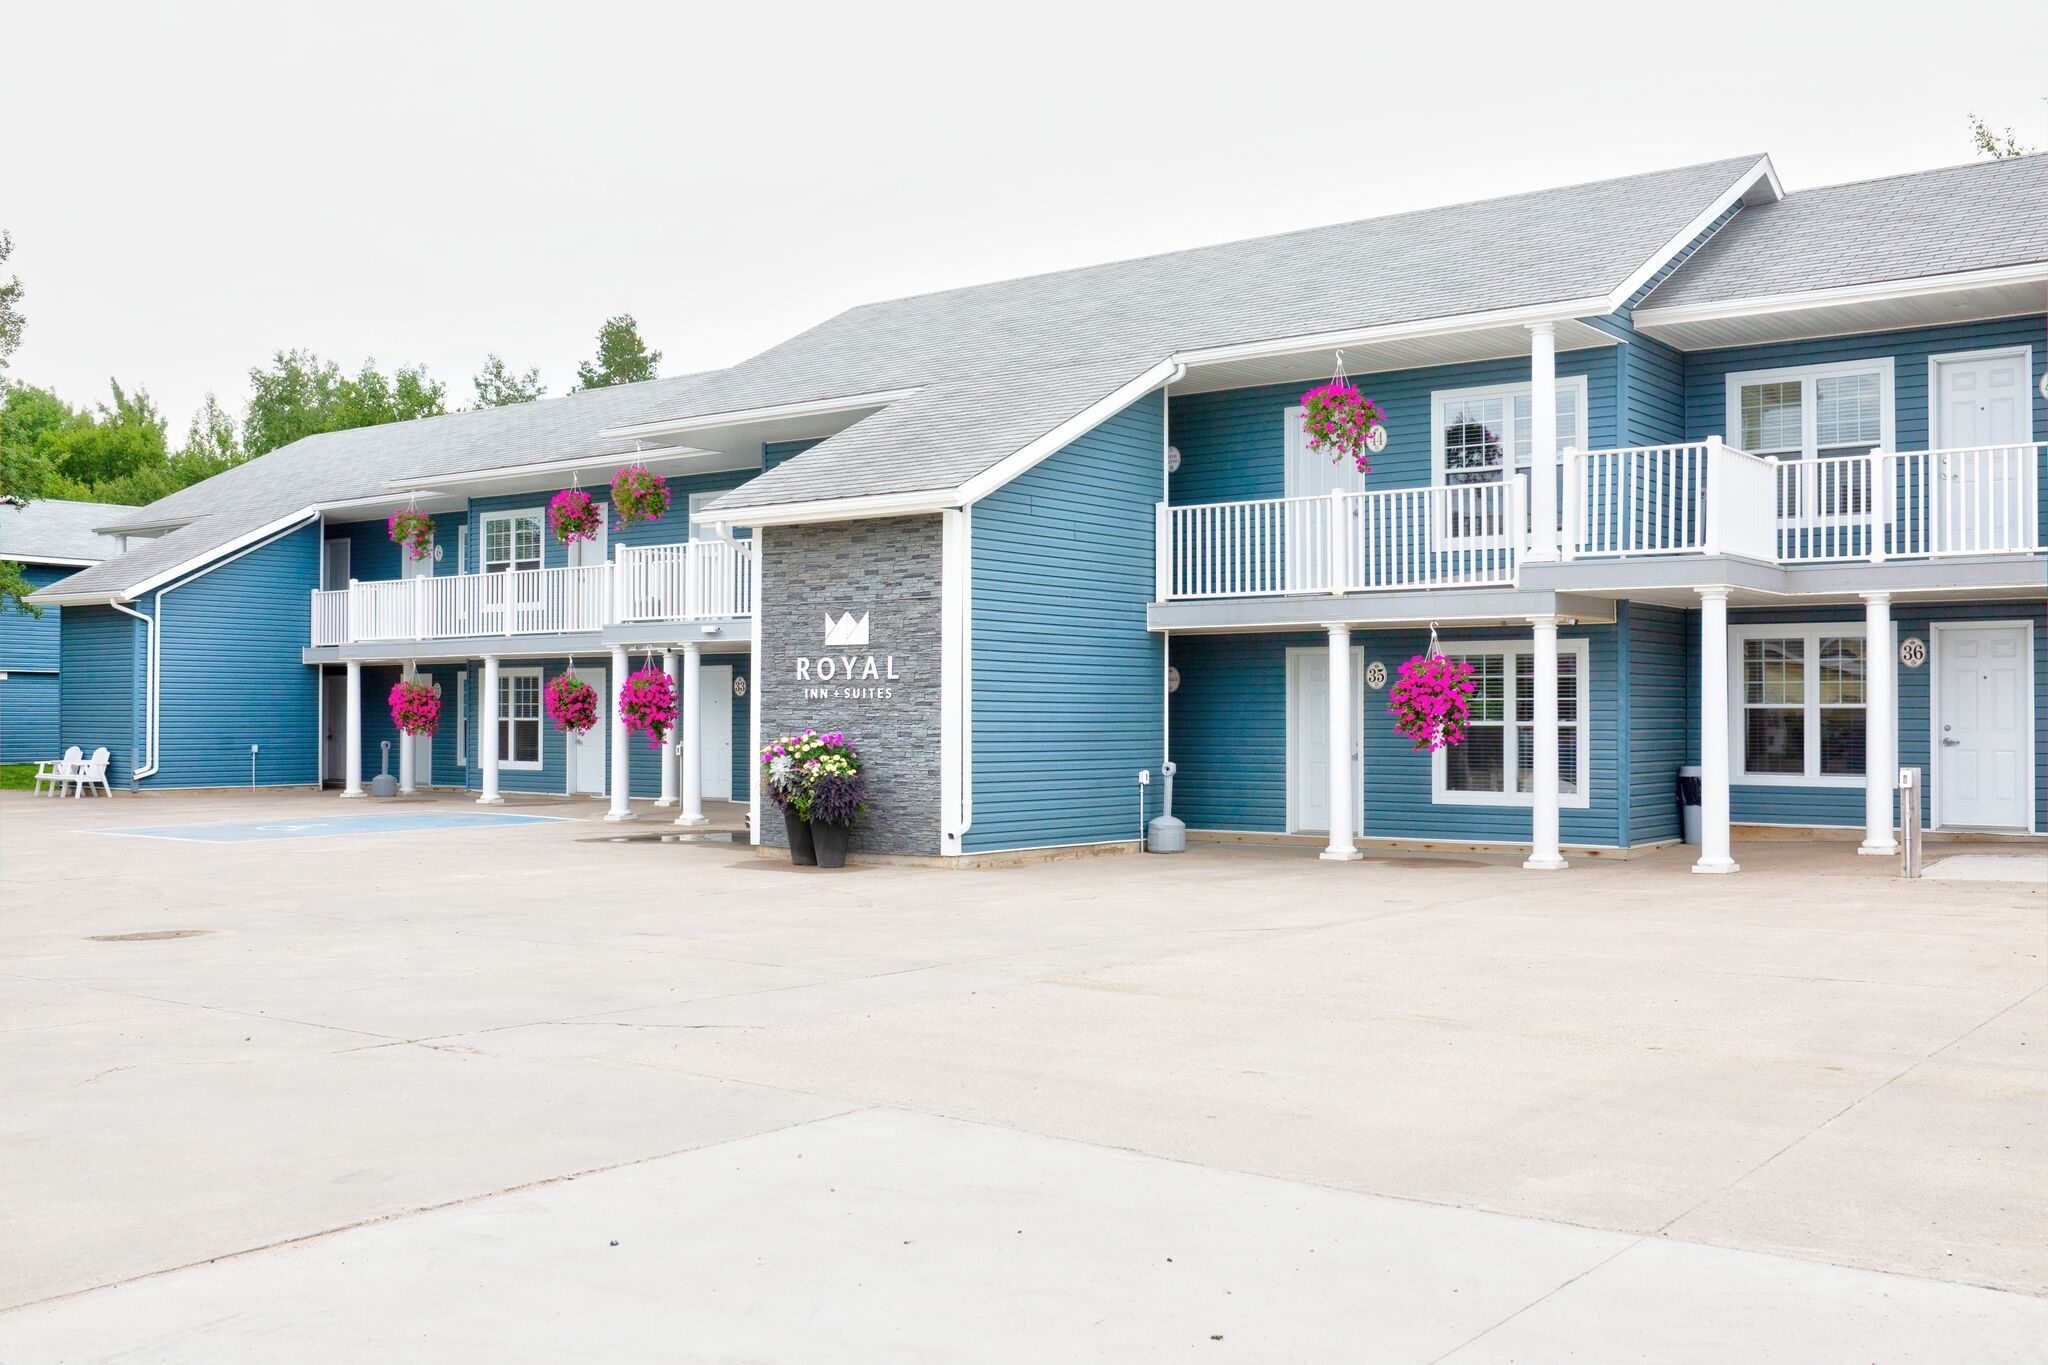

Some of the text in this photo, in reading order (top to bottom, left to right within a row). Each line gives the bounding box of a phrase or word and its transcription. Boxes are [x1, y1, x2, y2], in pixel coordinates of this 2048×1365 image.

[1903, 645, 1924, 661] 36
[796, 656, 899, 680] ROYAL
[1368, 668, 1385, 683] 35
[735, 681, 745, 692] 33
[804, 689, 828, 698] INN
[844, 688, 892, 698] SUITES
